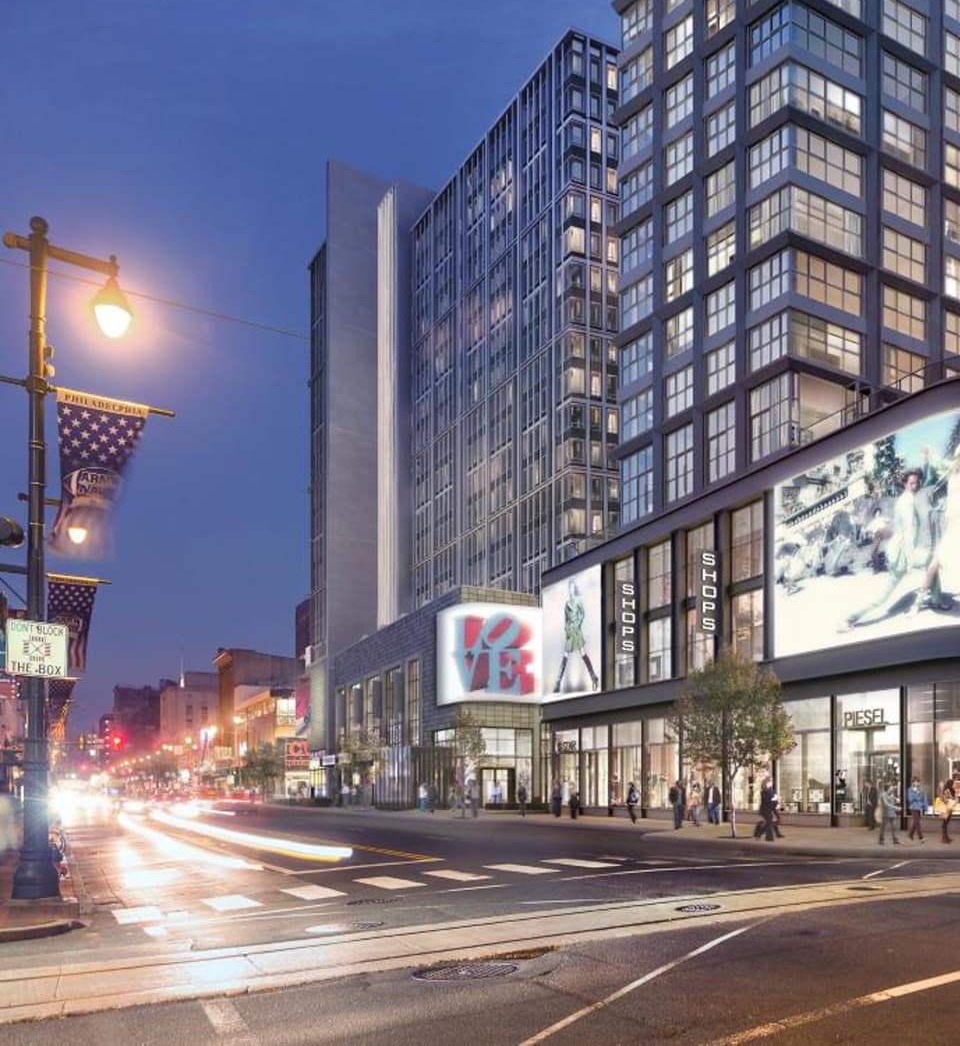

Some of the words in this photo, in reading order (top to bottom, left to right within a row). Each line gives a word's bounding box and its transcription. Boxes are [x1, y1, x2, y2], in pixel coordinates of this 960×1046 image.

[64, 393, 143, 415] PHILADELPHIA
[702, 552, 717, 631] SHOPS
[622, 583, 636, 652] SHOPS
[11, 660, 32, 673] THE
[38, 663, 62, 675] BOX
